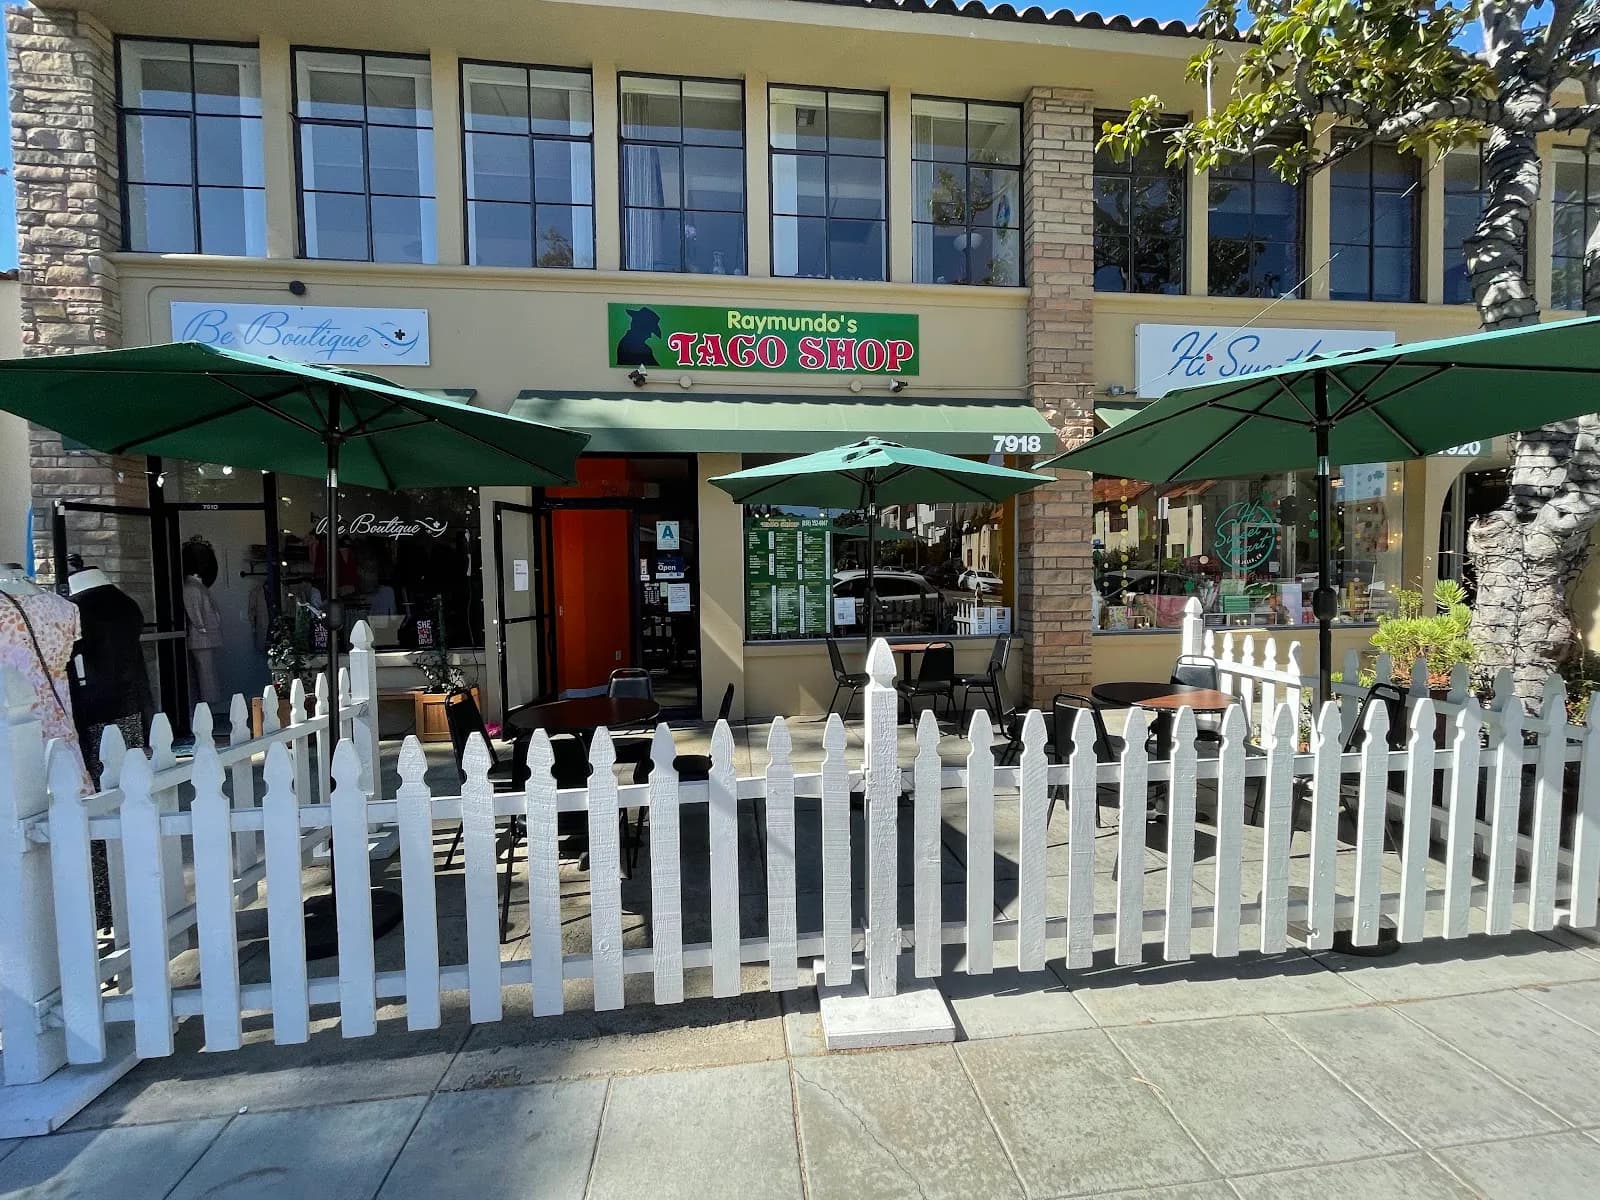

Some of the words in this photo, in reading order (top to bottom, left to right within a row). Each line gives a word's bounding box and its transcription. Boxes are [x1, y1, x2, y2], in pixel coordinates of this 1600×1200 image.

[182, 309, 236, 345] Be
[243, 311, 371, 360] Boutique
[727, 310, 858, 334] Raymundo's
[668, 332, 788, 369] TACO
[798, 336, 914, 372] SHOP
[1167, 331, 1218, 377] Hi
[992, 435, 1041, 453] 7918
[349, 513, 421, 541] Boutique
[662, 525, 674, 539] A
[657, 564, 676, 572] Open
